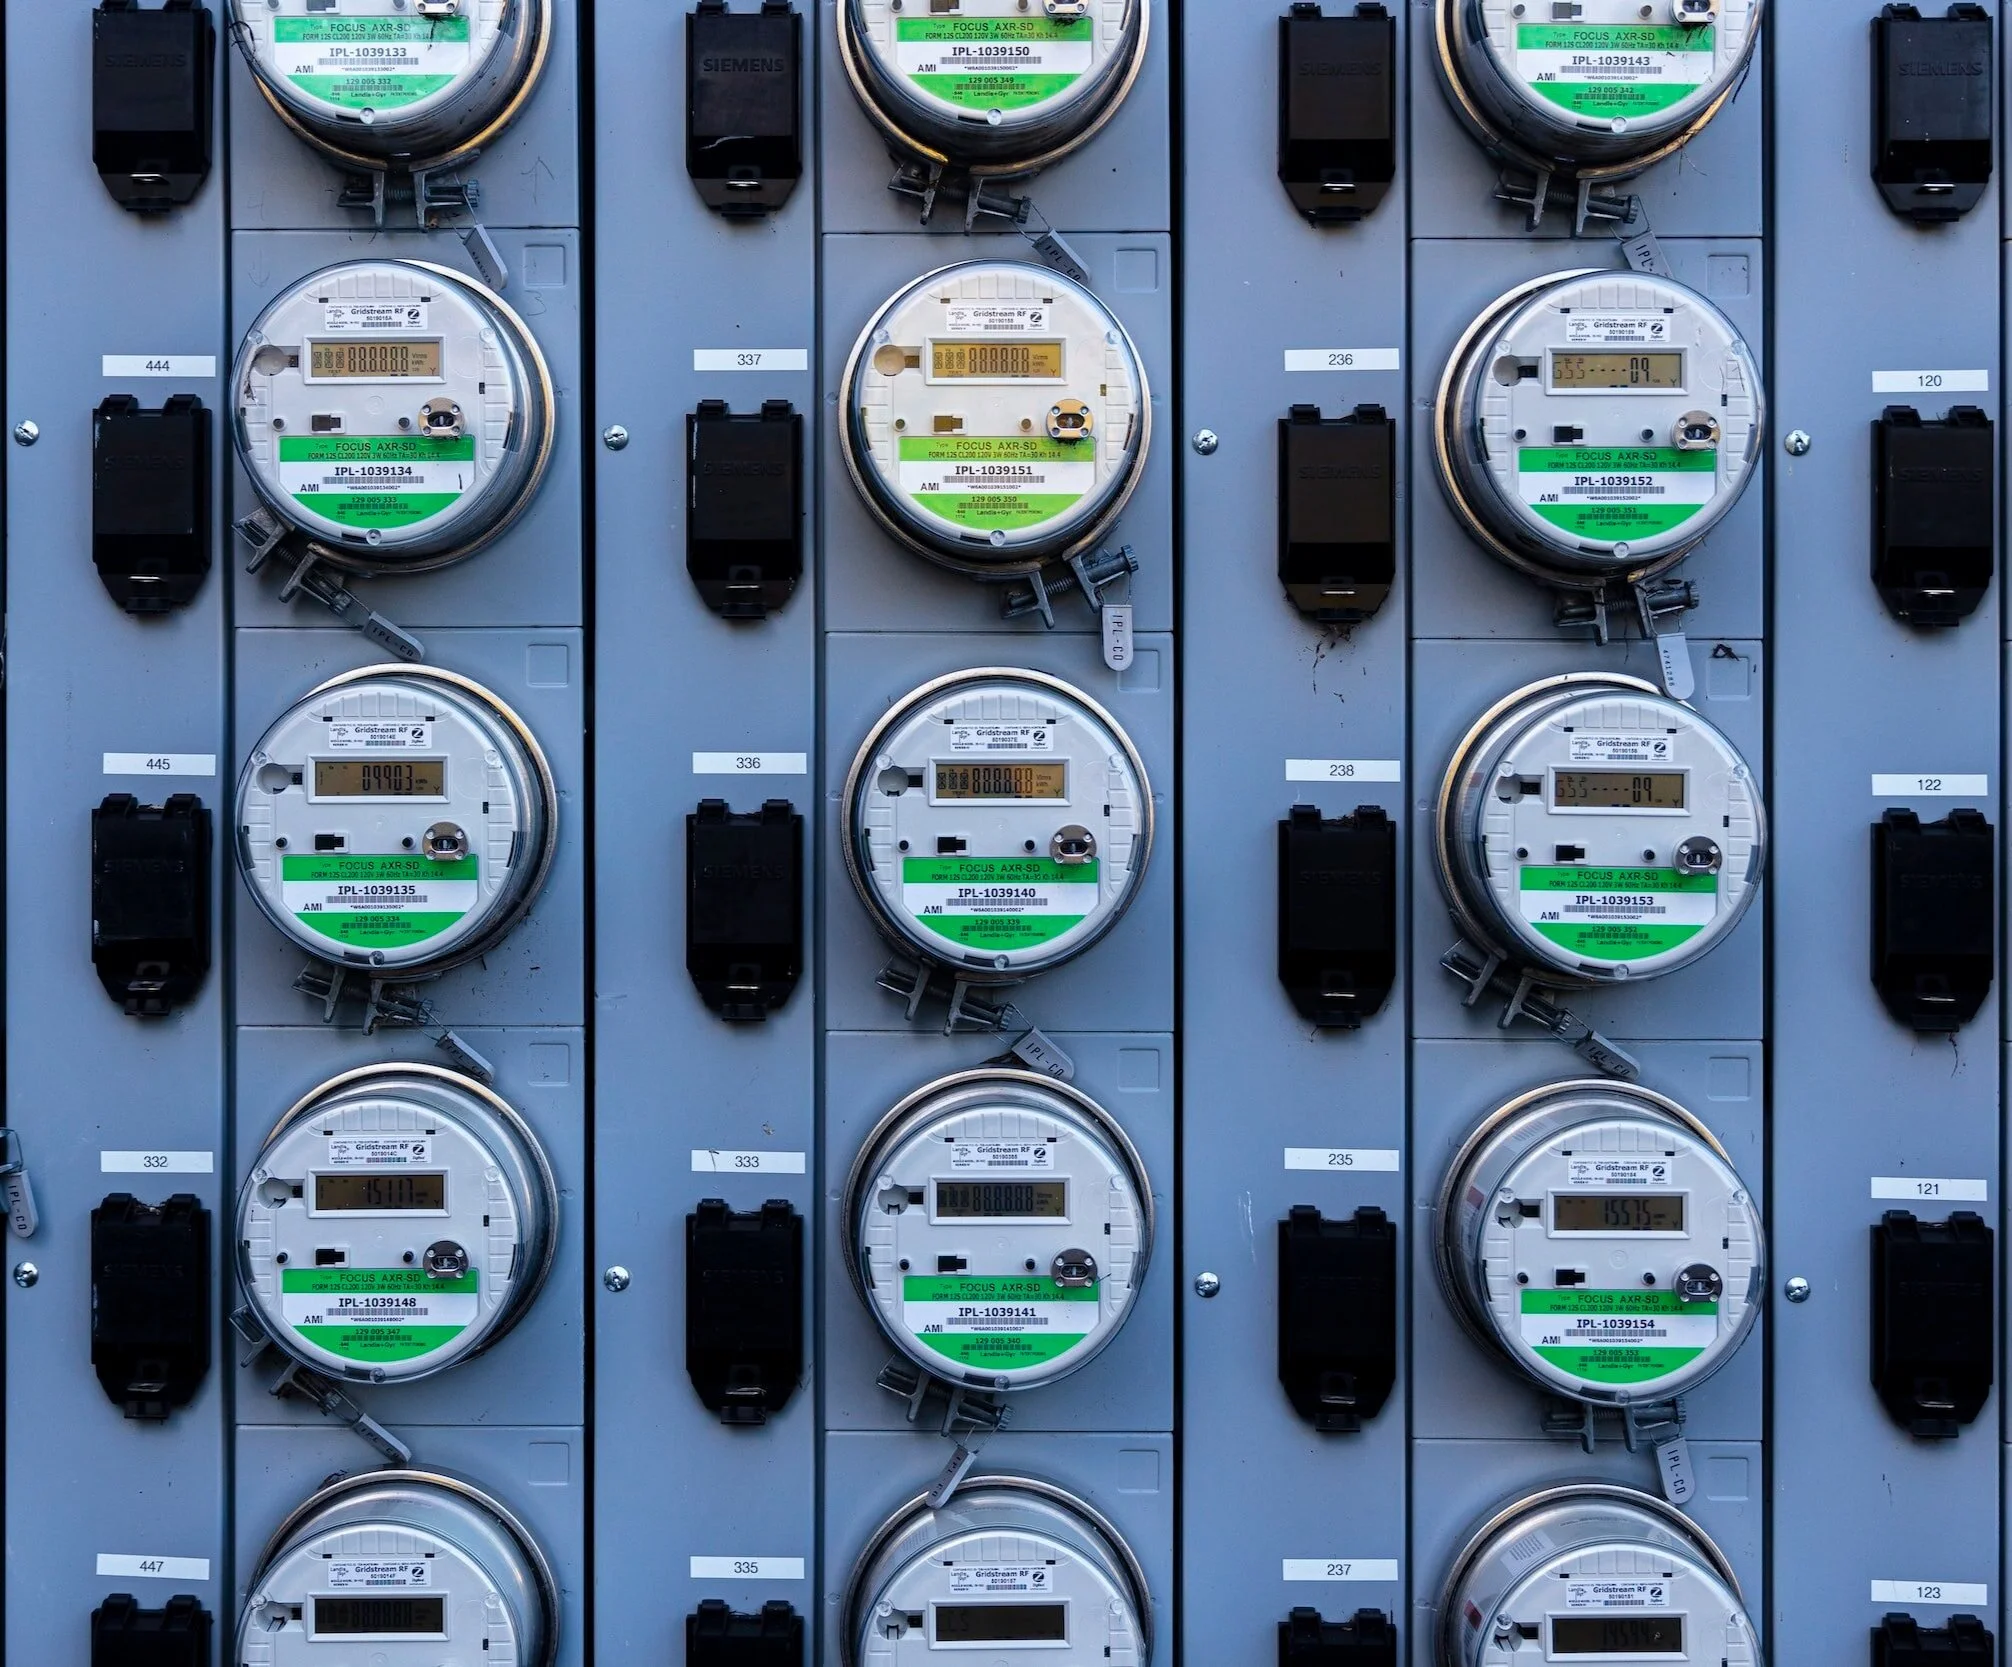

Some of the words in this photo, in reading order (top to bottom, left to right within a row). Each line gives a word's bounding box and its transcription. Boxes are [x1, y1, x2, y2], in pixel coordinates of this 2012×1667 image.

[372, 24, 410, 32] AXR-SD
[995, 22, 1033, 30] AXR-SD
[1574, 31, 1609, 39] FOCUS
[1616, 32, 1654, 40] AXR-SD
[330, 48, 406, 57] IPL-1039133
[952, 47, 1029, 56] IPL-1039150
[105, 53, 186, 68] SIEMENS
[1572, 56, 1650, 65] IPL-1039143
[295, 65, 313, 73] AMI
[703, 58, 784, 73] SIEMENS
[1299, 60, 1381, 76] SIEMENS
[1898, 60, 1982, 77] SIEMENS
[1537, 73, 1556, 81] AMI
[737, 353, 762, 366] 337
[1328, 353, 1353, 366] 236
[145, 360, 170, 372] 444
[1918, 374, 1942, 387] 120
[336, 443, 371, 451] FOCUS
[1618, 452, 1657, 460] AXR-SD
[335, 467, 412, 475] IPL-1039134
[955, 466, 1032, 475] IPL-1039151
[1575, 477, 1653, 486] IPL-1039152
[300, 484, 318, 492] AMI
[921, 484, 939, 492] AMI
[1112, 614, 1123, 661] IPL-CO
[146, 758, 171, 771] 445
[736, 757, 761, 769] 336
[1329, 764, 1355, 777] 238
[362, 765, 412, 790] 09903
[1917, 778, 1942, 791] 122
[339, 862, 374, 870] FOCUS
[1578, 872, 1613, 880] FOCUS
[1620, 873, 1659, 881] AXR-SD
[338, 886, 415, 895] IPL-1039135
[959, 889, 1036, 897] IPL-1039140
[1576, 896, 1654, 906] IPL-1039153
[1540, 913, 1558, 921] AMI
[1025, 1042, 1065, 1077] IPL-CO
[143, 1155, 168, 1168] 332
[734, 1155, 760, 1168] 333
[1328, 1153, 1353, 1166] 235
[1916, 1182, 1939, 1195] 121
[340, 1274, 375, 1282] FOCUS
[382, 1274, 421, 1282] AXR-SD
[960, 1283, 995, 1291] FOCUS
[339, 1299, 416, 1307] IPL-1039148
[1578, 1295, 1613, 1303] FOCUS
[1620, 1295, 1659, 1303] AXR-SD
[959, 1307, 1036, 1316] IPL-1039141
[303, 1316, 322, 1324] AMI
[1577, 1320, 1655, 1329] IPL-1039154
[924, 1324, 942, 1332] AMI
[1668, 1449, 1684, 1495] IPL-CO
[139, 1560, 165, 1573] 447
[734, 1561, 759, 1574] 335
[1327, 1563, 1352, 1576] 237
[1917, 1586, 1942, 1599] 123
